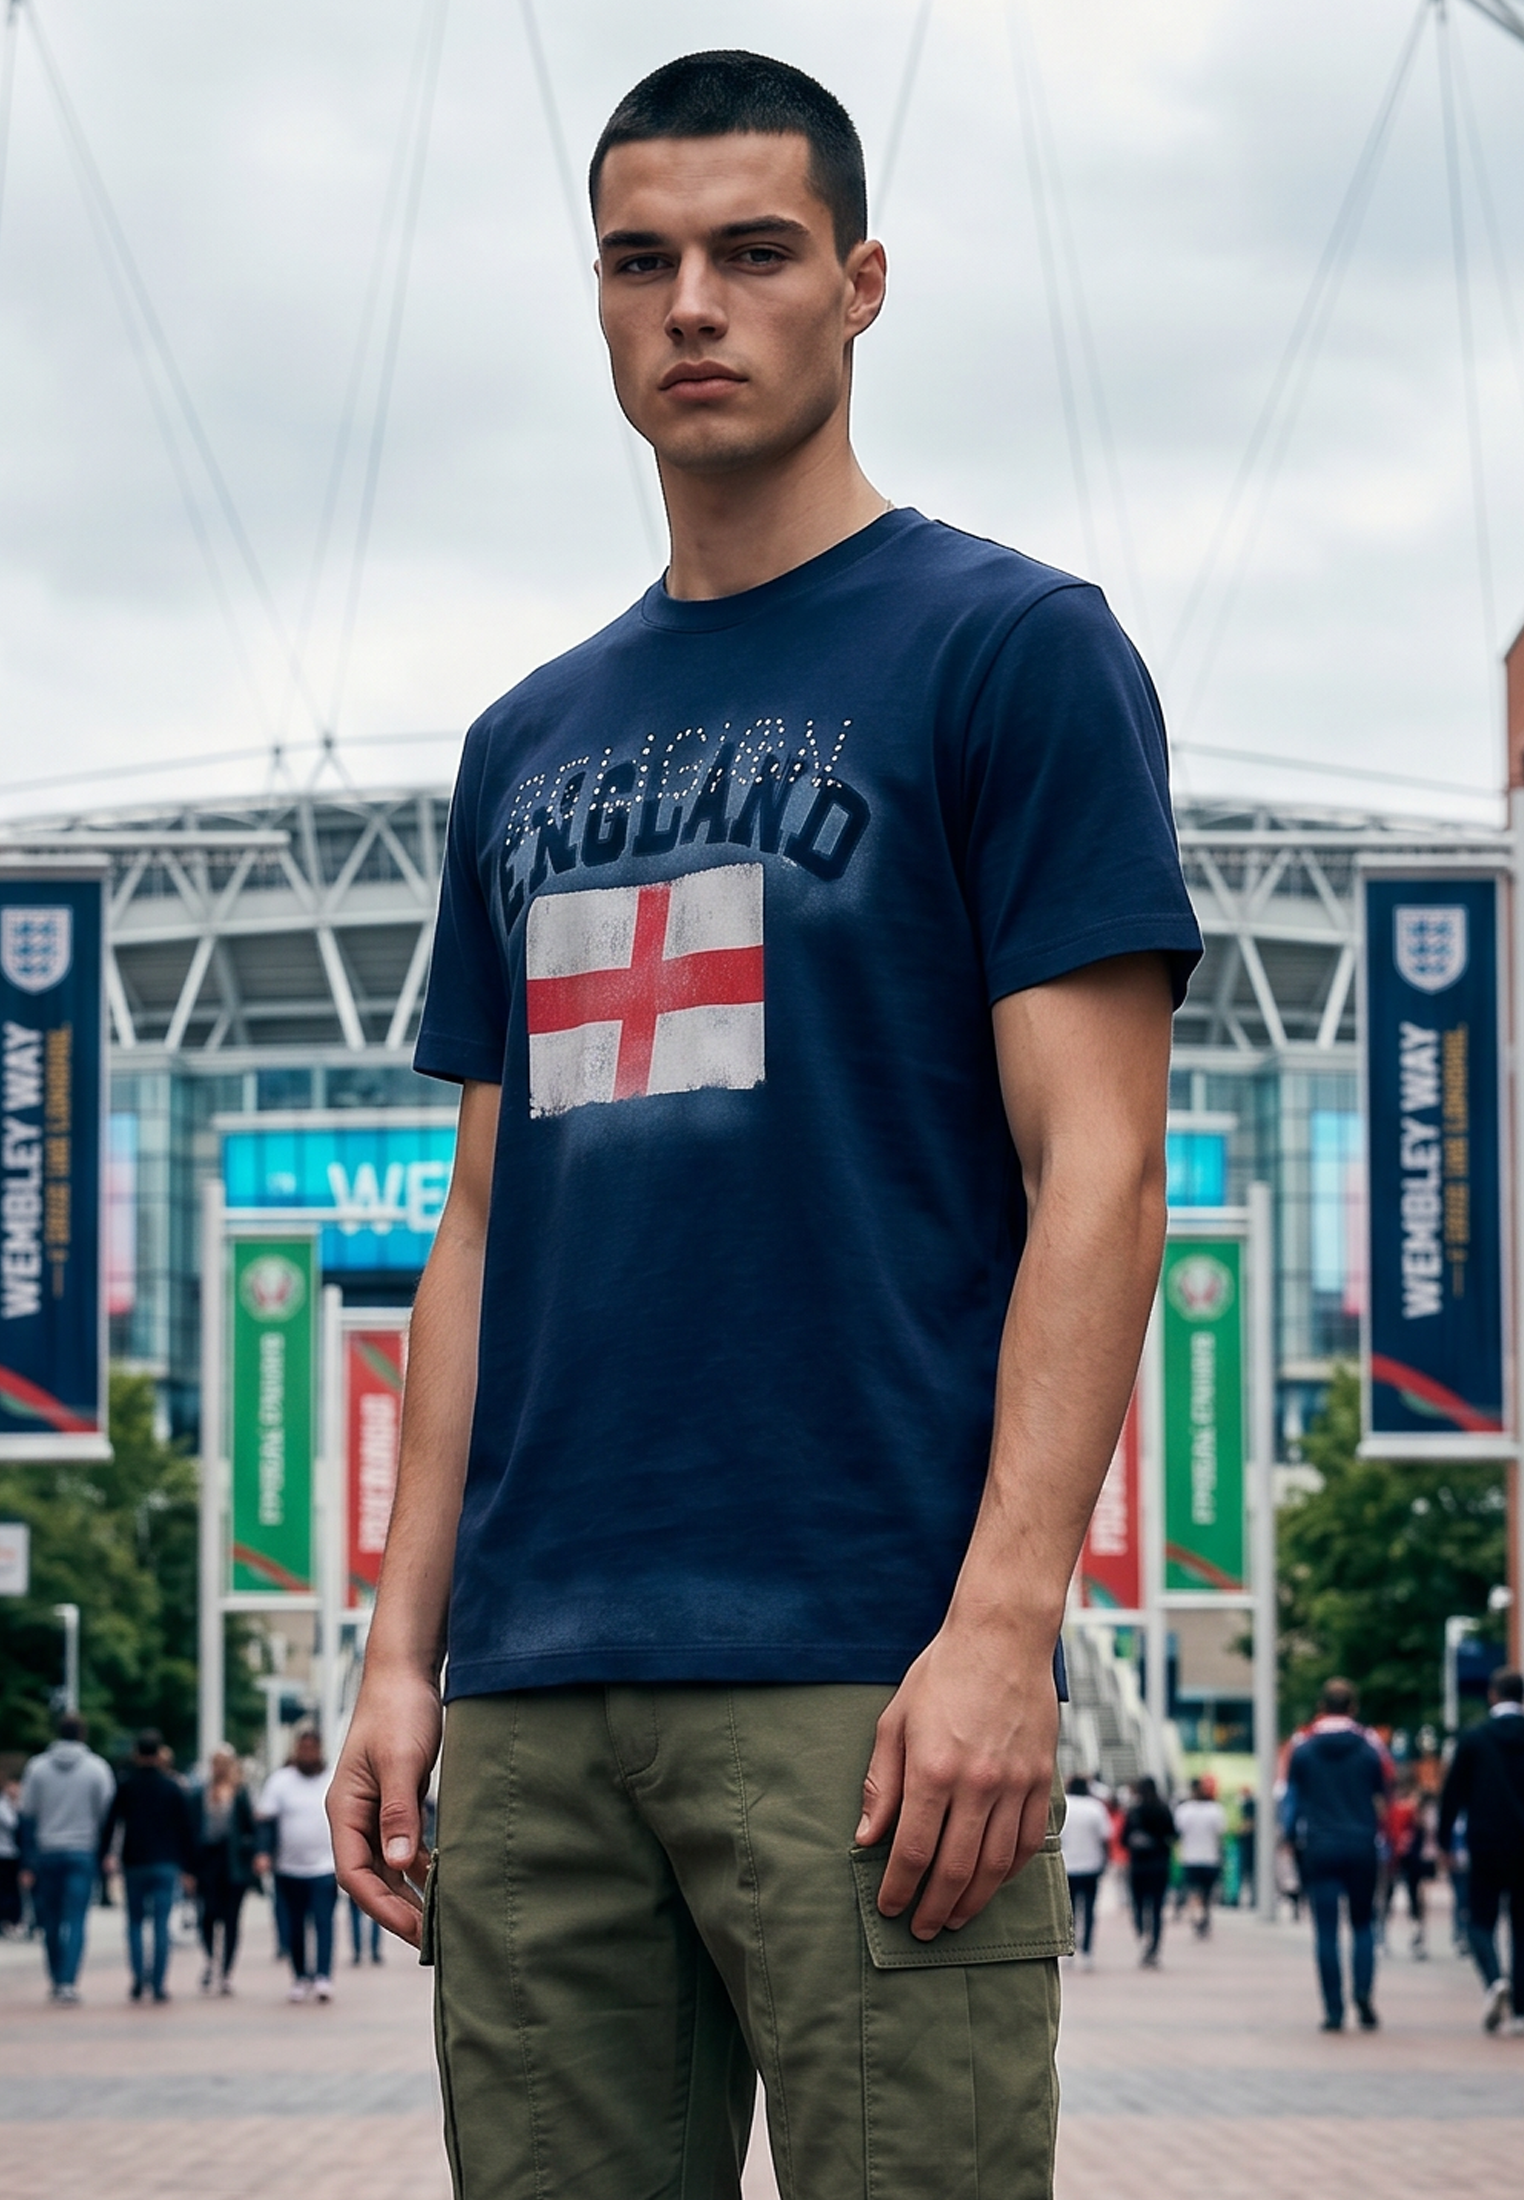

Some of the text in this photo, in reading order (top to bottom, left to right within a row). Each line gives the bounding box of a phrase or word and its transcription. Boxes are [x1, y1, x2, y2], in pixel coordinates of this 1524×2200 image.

[500, 742, 871, 936] ENGLAND
[1, 1021, 42, 1319] WEMBLEY WAY
[327, 1161, 453, 1235] WE
[1400, 1021, 1442, 1319] WEMBLEY WAY
